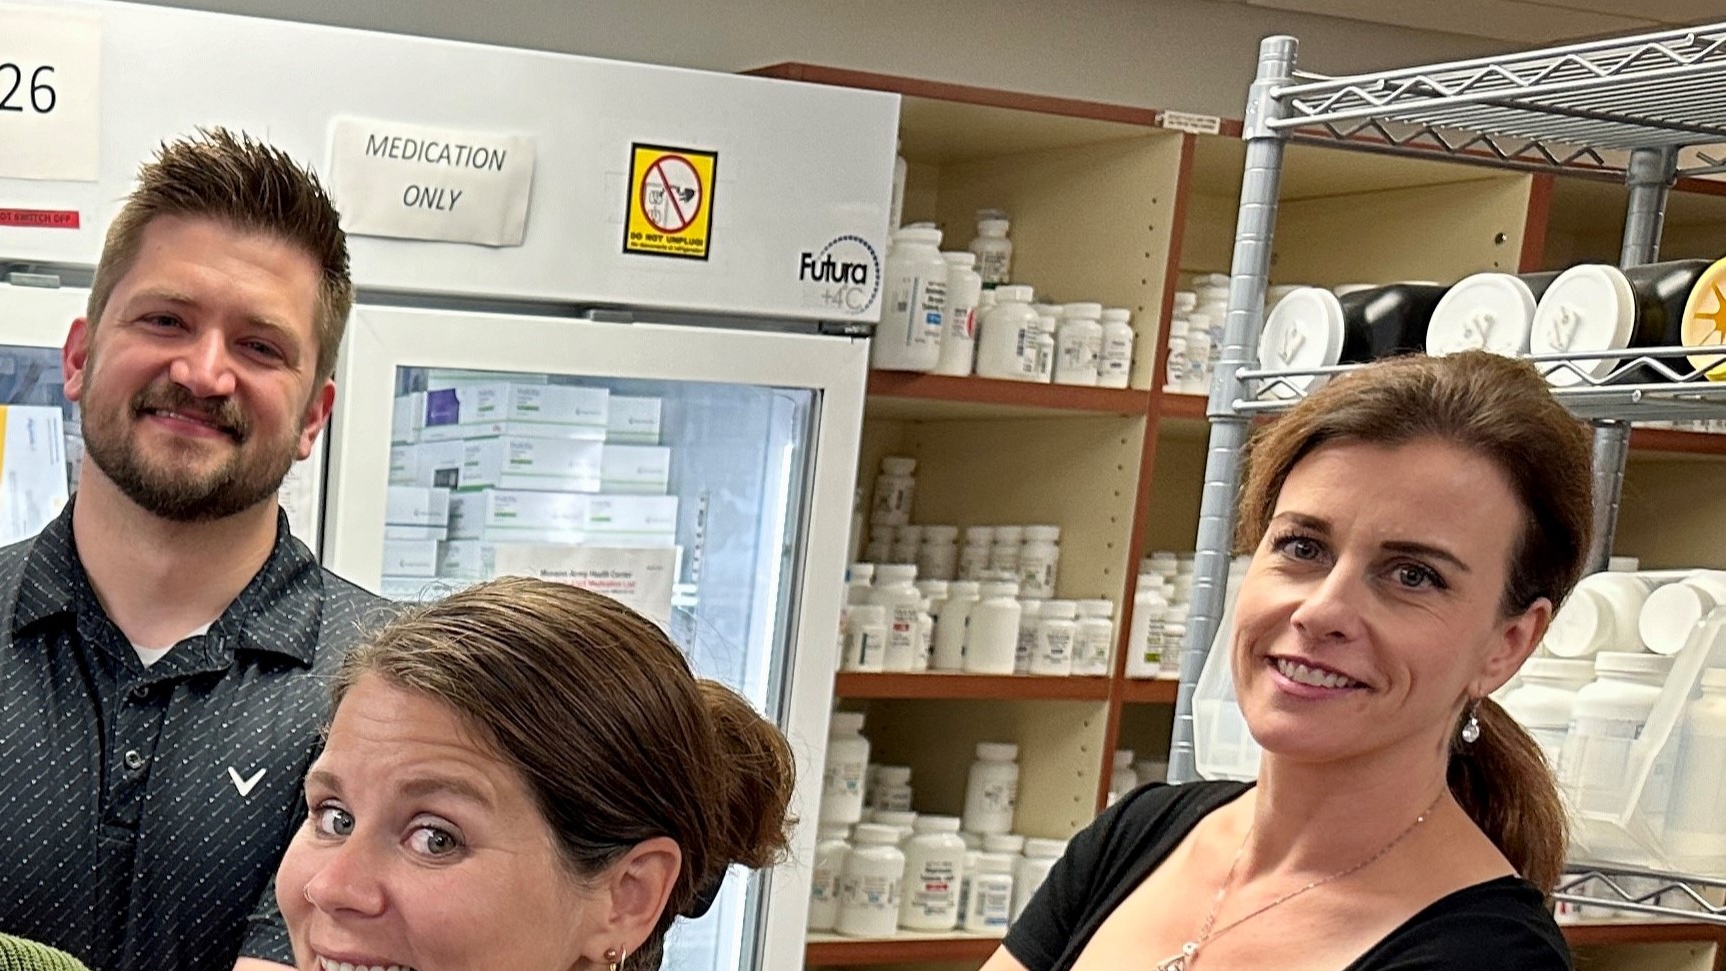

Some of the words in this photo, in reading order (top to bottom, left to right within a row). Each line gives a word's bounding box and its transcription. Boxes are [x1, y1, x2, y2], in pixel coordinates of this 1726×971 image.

[365, 134, 507, 172] MEDICATION
[403, 184, 463, 212] ONLY
[13, 213, 51, 223] SWITCH
[799, 252, 868, 285] Futura
